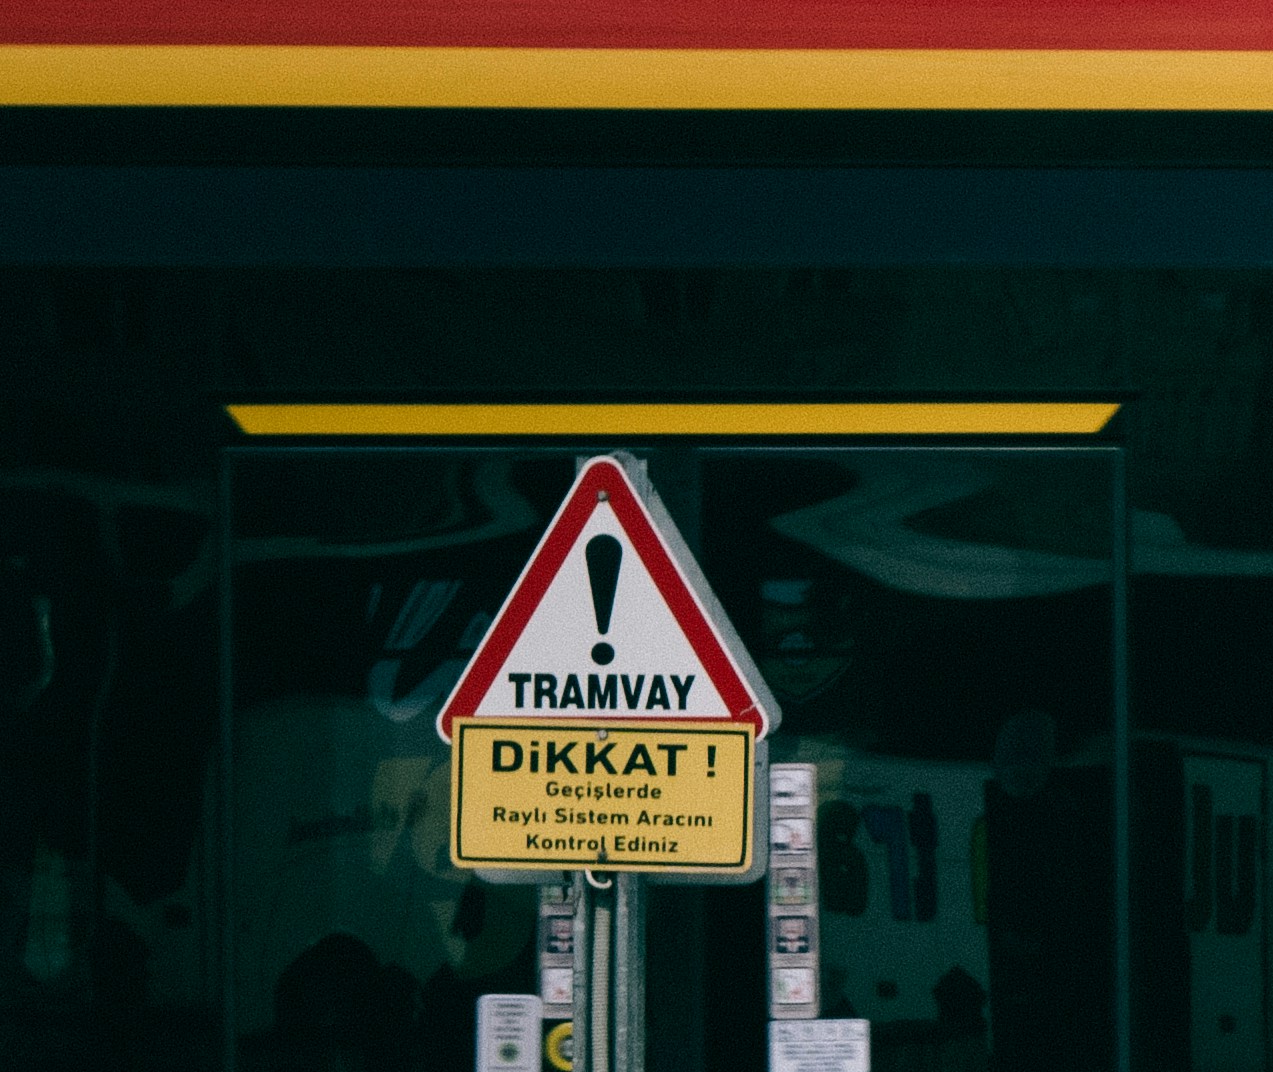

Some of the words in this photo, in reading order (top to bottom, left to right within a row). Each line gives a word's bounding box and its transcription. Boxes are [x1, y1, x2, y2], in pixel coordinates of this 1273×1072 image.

[508, 673, 696, 710] TRAMVAY
[706, 745, 717, 777] !
[546, 781, 662, 800] Geçişlerde
[493, 807, 546, 825] Raylı
[555, 808, 629, 825] Sistem
[637, 811, 713, 827] Aracını
[526, 834, 606, 851] Kontrol
[614, 836, 679, 853] Ediniz
